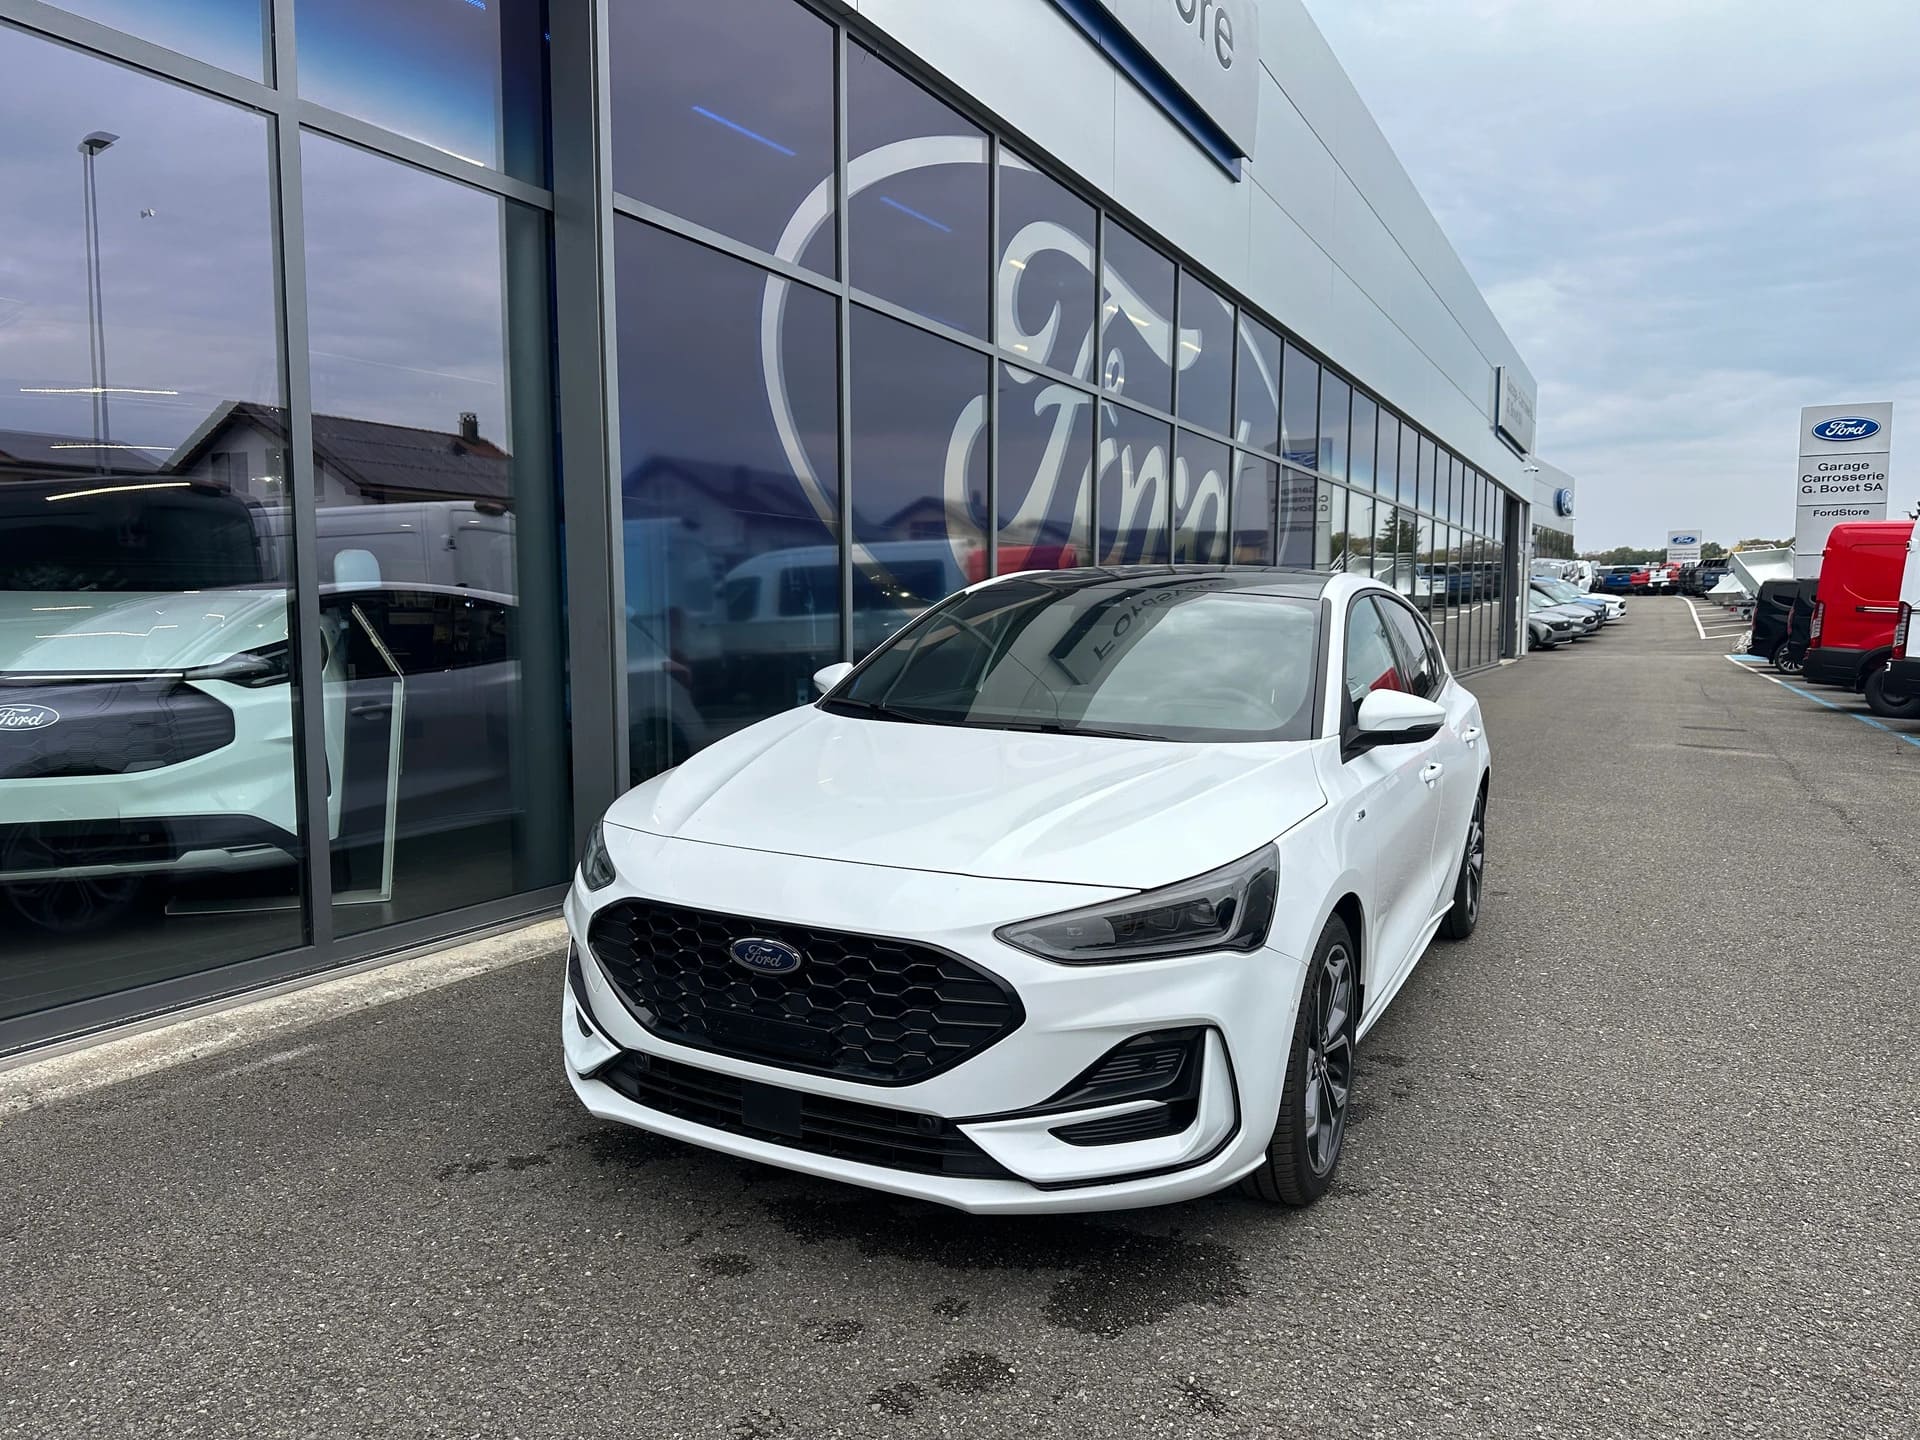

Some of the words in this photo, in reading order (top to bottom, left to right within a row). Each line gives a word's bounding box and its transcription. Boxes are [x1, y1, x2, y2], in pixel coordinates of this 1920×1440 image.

[1825, 420, 1867, 436] Ford
[1817, 462, 1870, 472] Garage
[1801, 471, 1885, 483] Carrosserie
[1801, 485, 1817, 494] G.
[1820, 483, 1861, 493] Bovet
[1863, 482, 1883, 492] SA
[1813, 508, 1870, 517] FordStore
[744, 944, 783, 968] Ford
